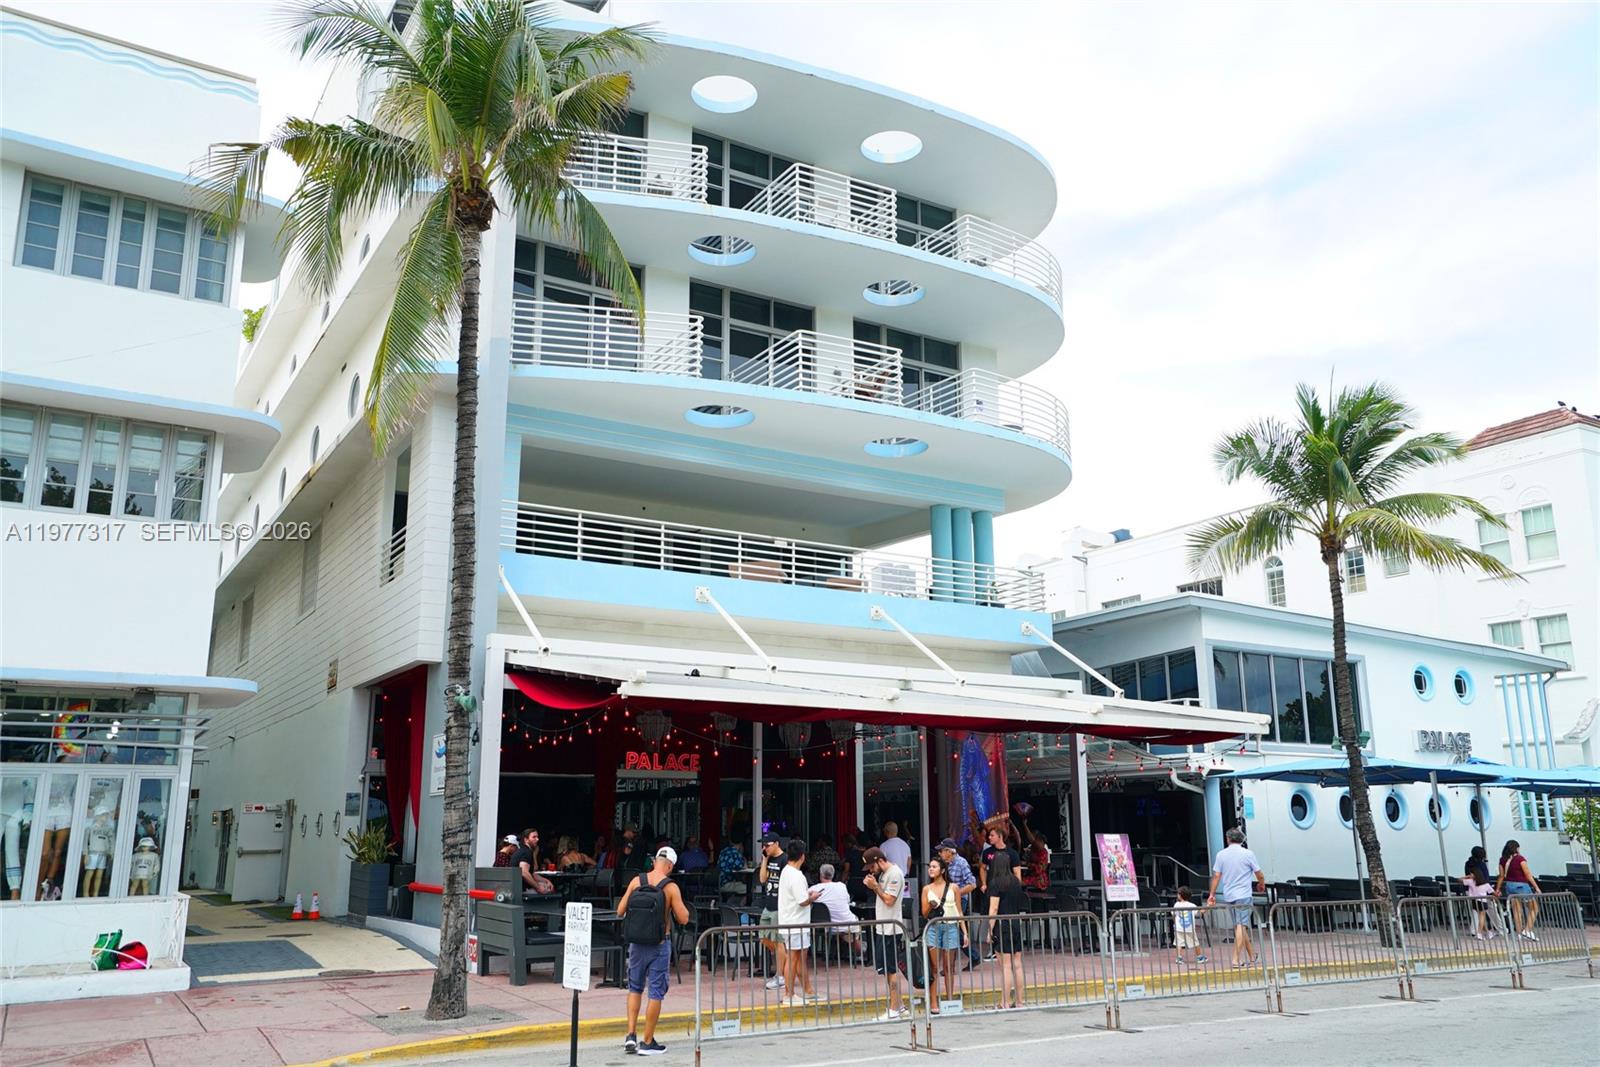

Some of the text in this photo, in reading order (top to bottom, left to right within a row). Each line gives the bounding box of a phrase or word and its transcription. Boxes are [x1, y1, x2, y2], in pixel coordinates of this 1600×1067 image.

[625, 751, 700, 772] PALACE
[568, 906, 590, 920] VALET
[566, 943, 589, 957] STRAND
